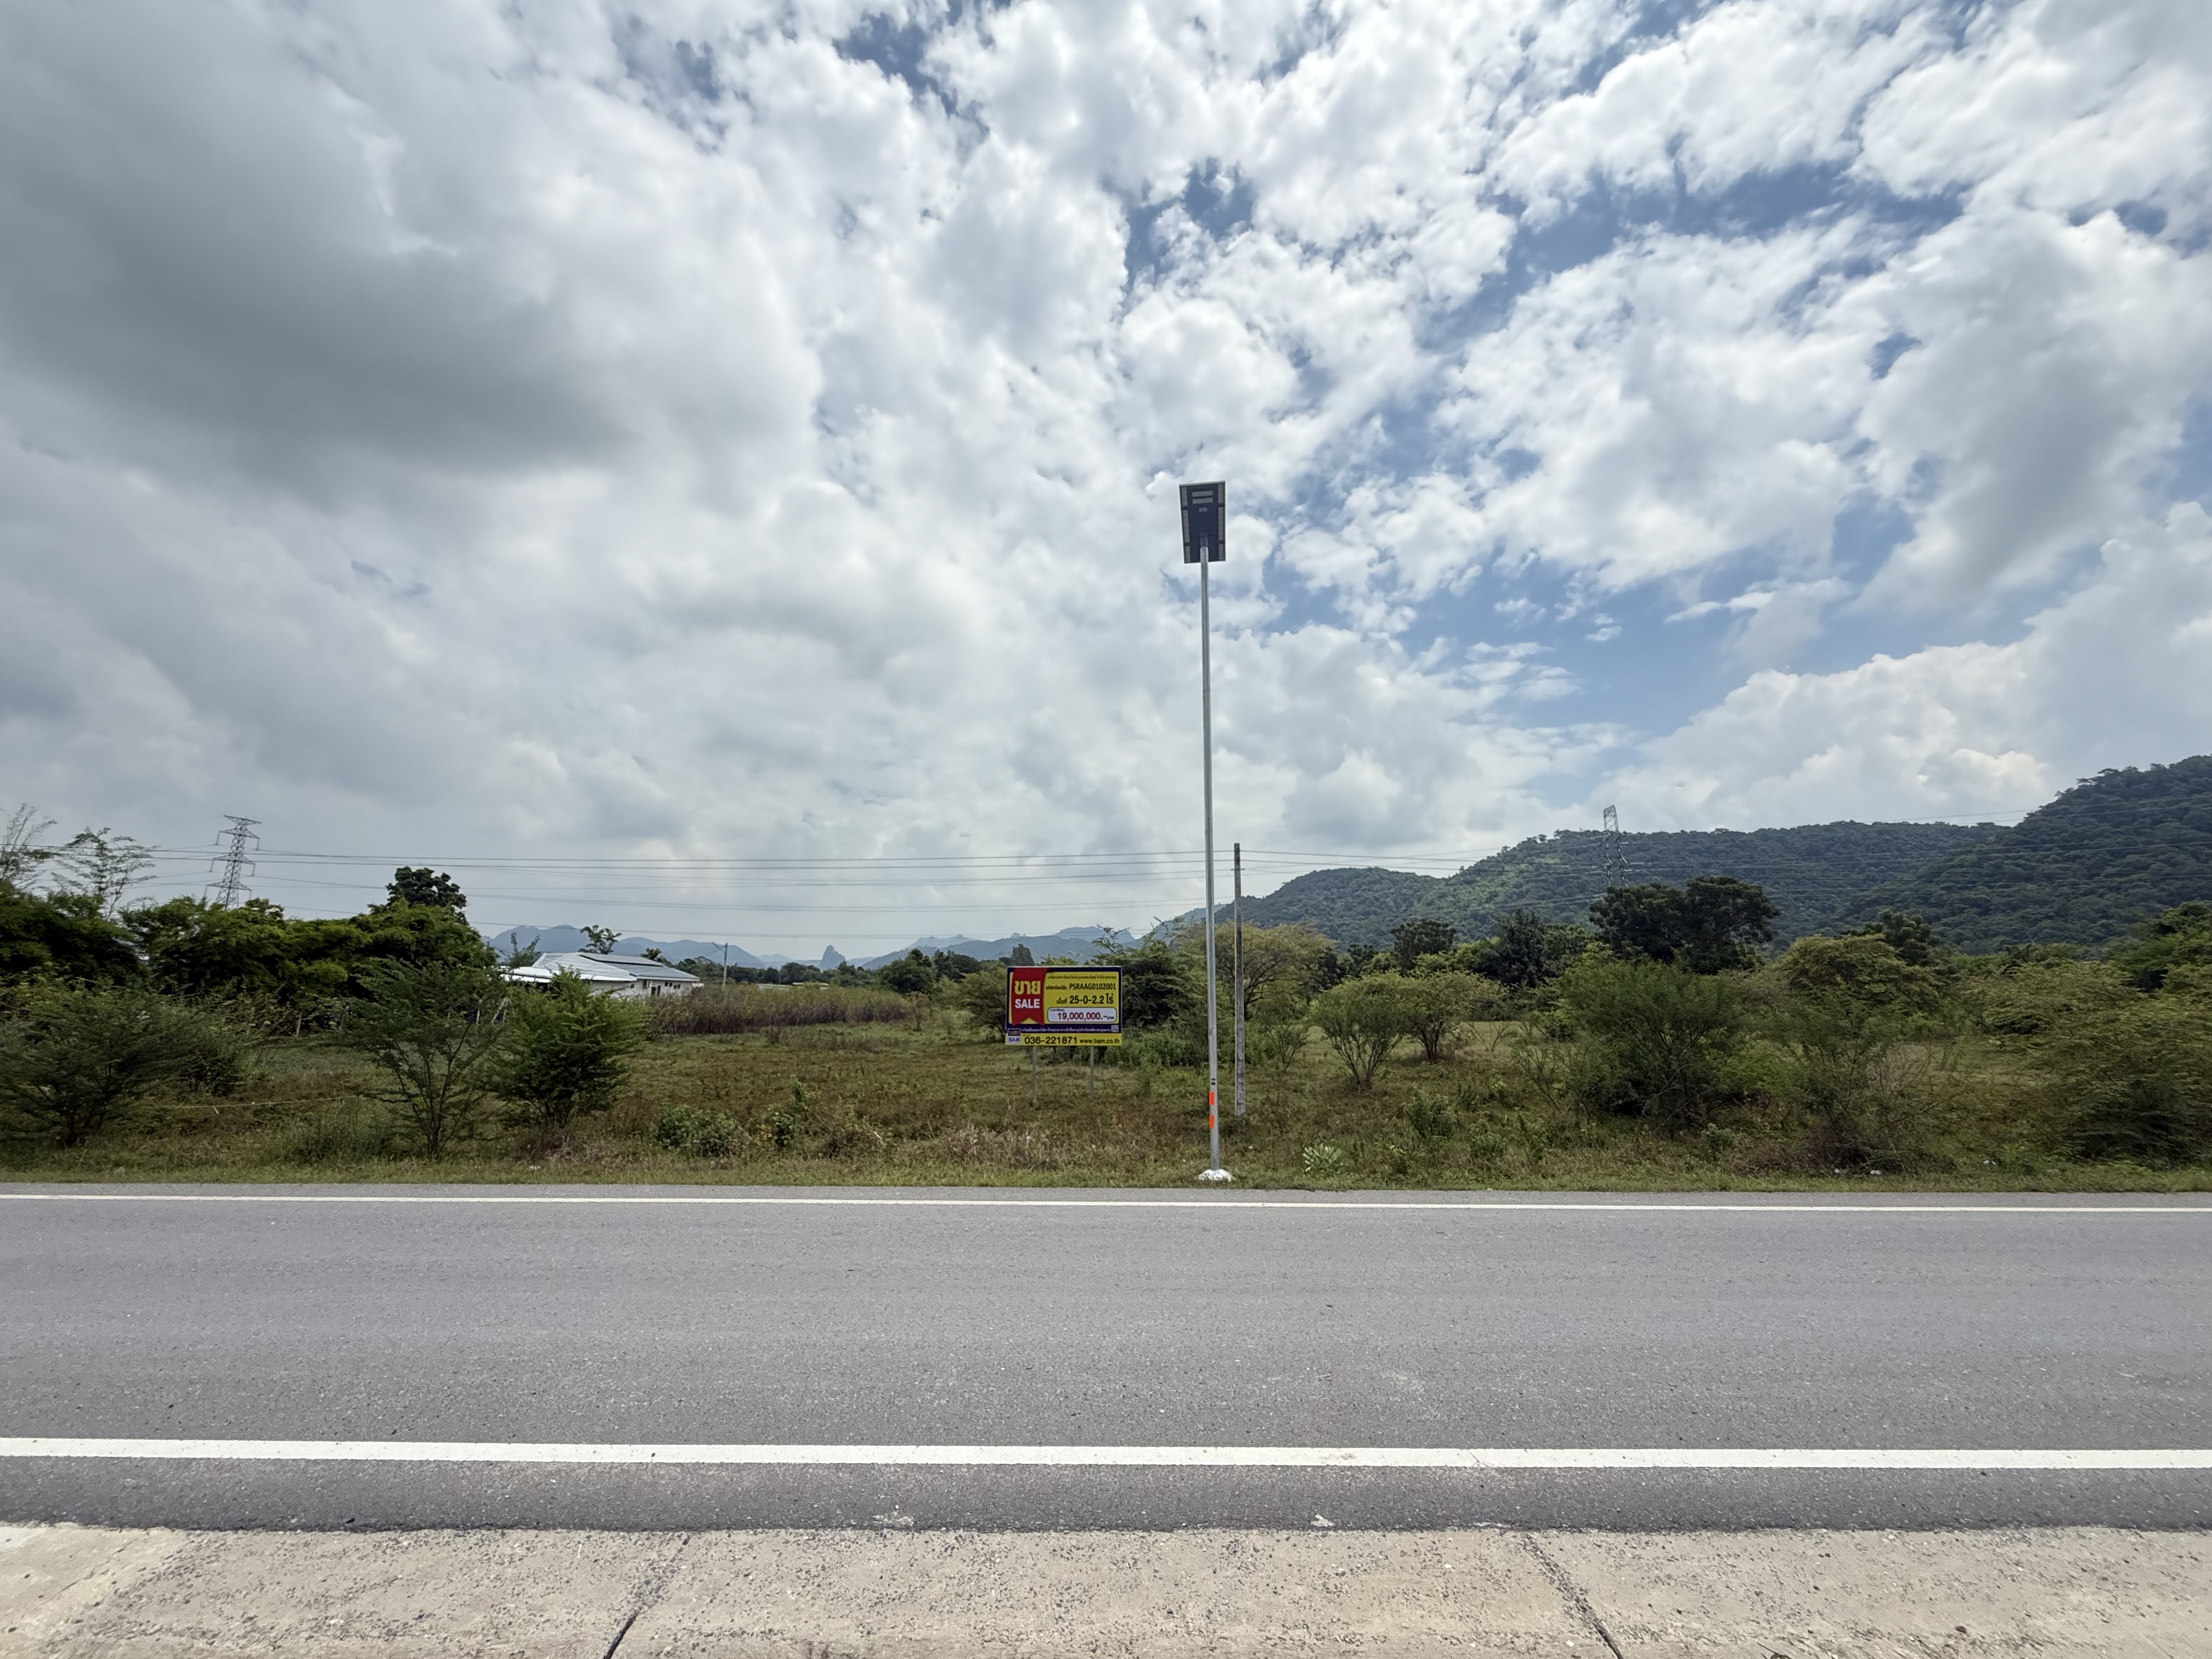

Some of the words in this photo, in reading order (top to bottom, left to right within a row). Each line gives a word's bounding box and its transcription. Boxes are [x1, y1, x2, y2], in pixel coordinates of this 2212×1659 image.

[1014, 980, 1041, 995] ขาย
[1014, 998, 1040, 1008] SALE
[1105, 993, 1114, 1005] ไร่
[1024, 1036, 1077, 1045] 036-221871
